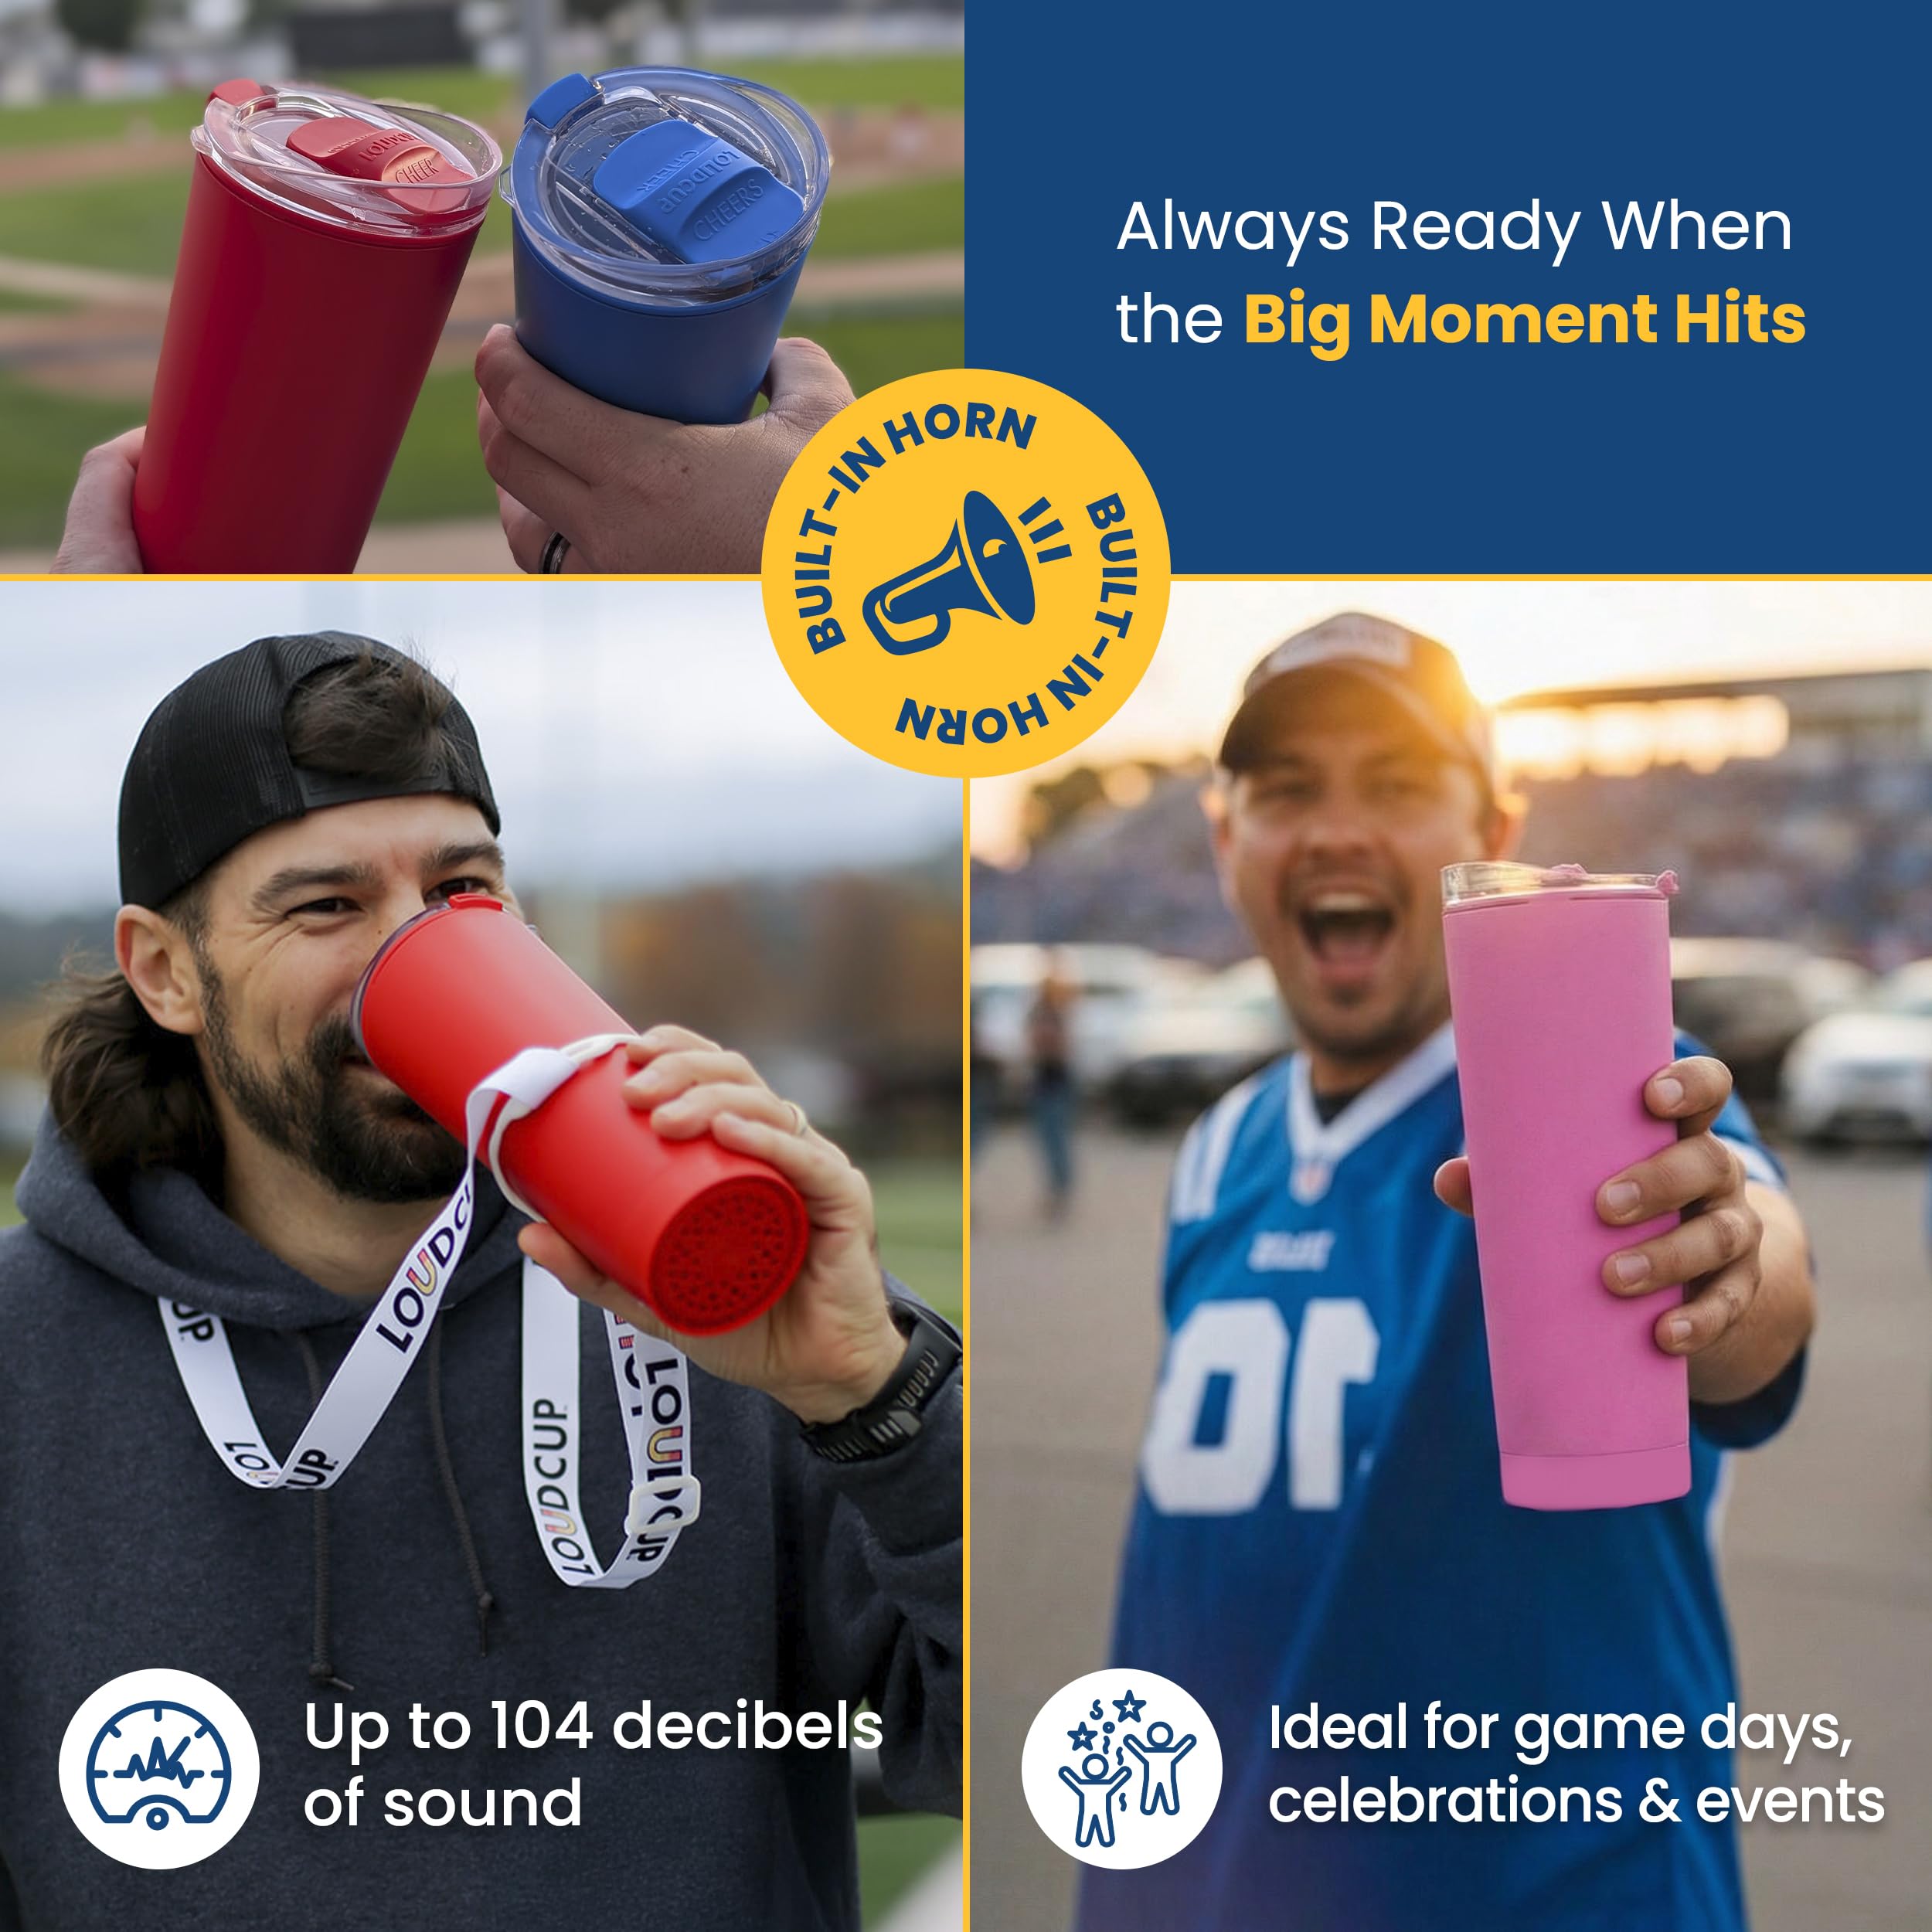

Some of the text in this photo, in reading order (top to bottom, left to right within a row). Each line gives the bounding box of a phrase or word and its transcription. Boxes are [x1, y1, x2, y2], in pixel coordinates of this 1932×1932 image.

[658, 150, 740, 216] LOUDCUP
[694, 178, 764, 241] CHEERS
[376, 1183, 470, 1353] LOUDC
[533, 1399, 594, 1575] LOUDCUP
